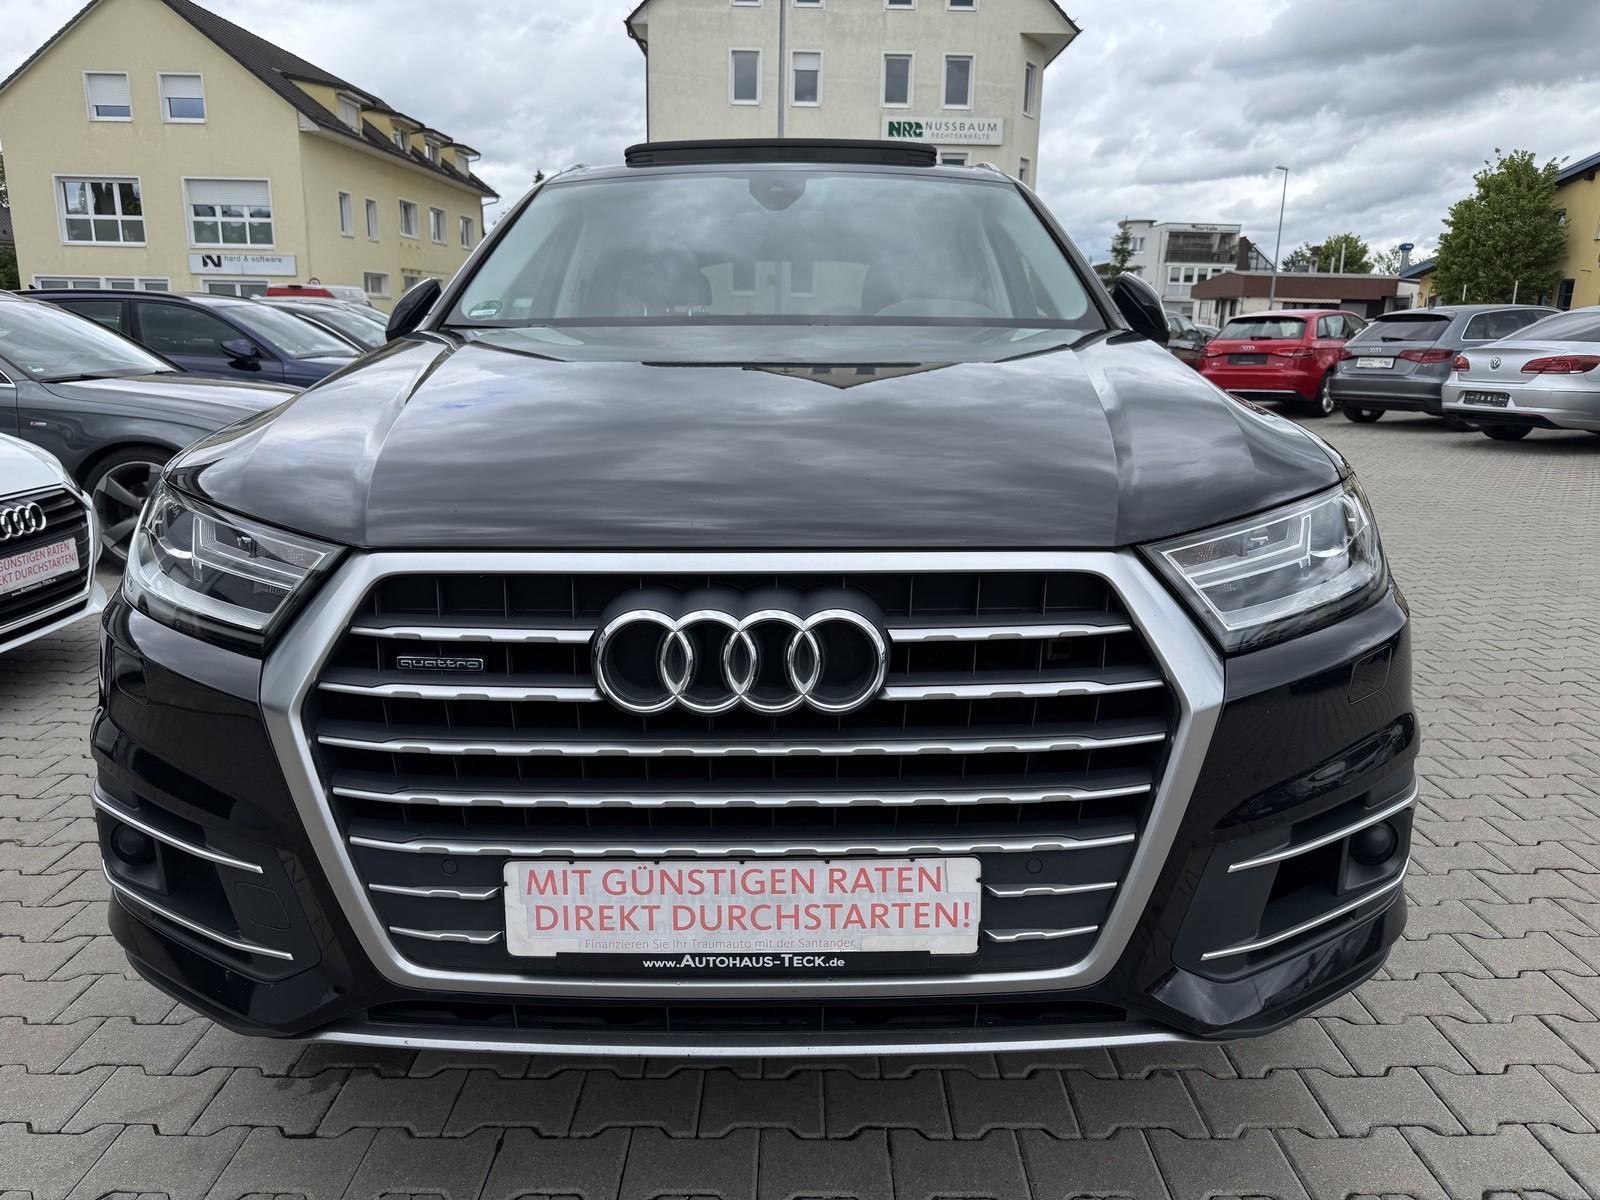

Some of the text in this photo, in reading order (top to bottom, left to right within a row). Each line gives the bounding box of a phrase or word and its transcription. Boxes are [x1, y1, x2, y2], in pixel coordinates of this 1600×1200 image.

[925, 122, 997, 133] NUSSBAUM
[47, 542, 70, 556] RATEN
[15, 552, 77, 580] DURCHSTARTEN!
[400, 659, 479, 668] quattro
[527, 866, 942, 896] MIT GÜNSTIGEN RATEN
[535, 902, 971, 931] DIREKT DURCHSTARTEN!
[586, 939, 650, 950] Finanzieren
[653, 939, 669, 950] Sie
[673, 939, 688, 950] Ihr
[692, 939, 752, 950] Traumauto
[755, 939, 774, 949] mit
[777, 938, 794, 949] der
